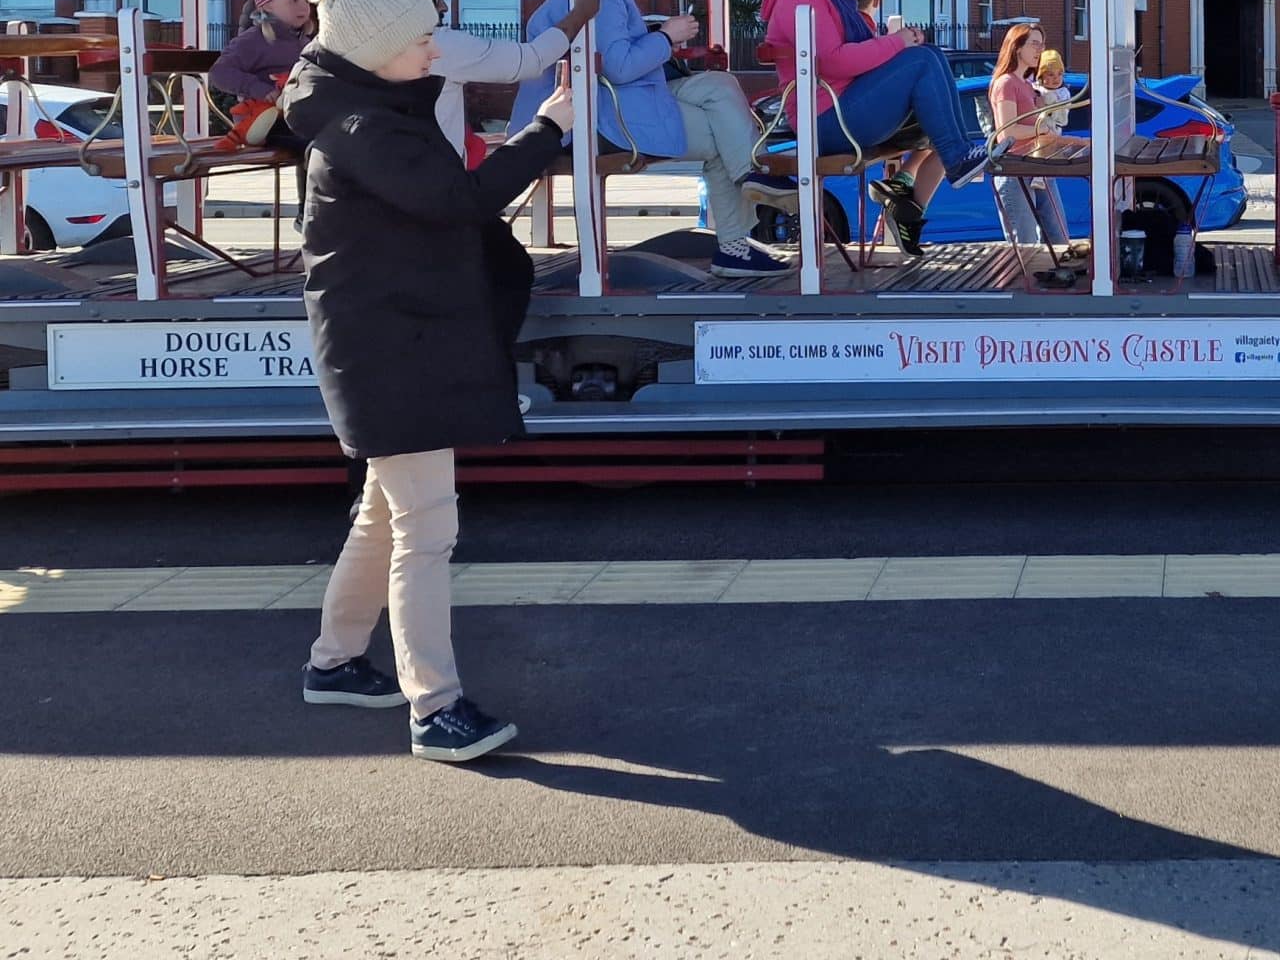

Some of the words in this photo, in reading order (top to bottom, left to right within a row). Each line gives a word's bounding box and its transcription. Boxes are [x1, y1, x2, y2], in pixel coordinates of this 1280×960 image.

[165, 331, 292, 352] DOUGLAS
[709, 345, 745, 360] JUMP,
[750, 345, 785, 360] SLIDE,
[789, 344, 828, 359] CLIMB
[832, 344, 840, 358] &
[844, 344, 884, 358] SWING
[889, 331, 966, 370] VISIT
[975, 335, 1111, 370] DRAGON'S
[1122, 333, 1224, 371] CASTLE
[140, 357, 229, 378] HORSE
